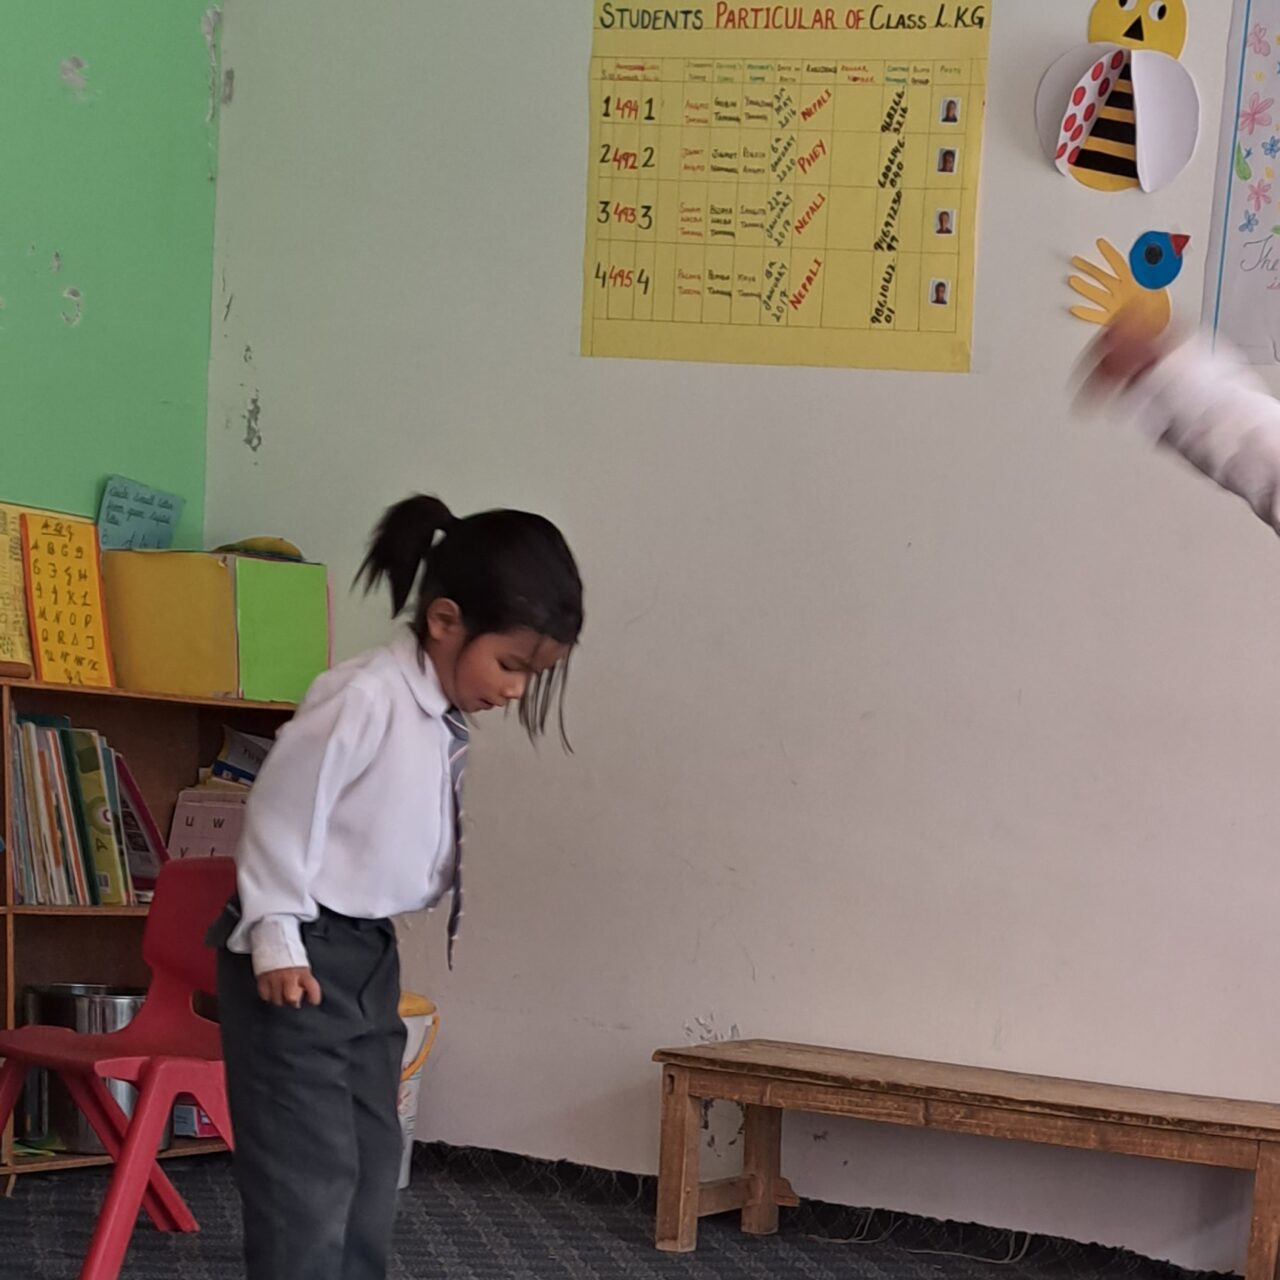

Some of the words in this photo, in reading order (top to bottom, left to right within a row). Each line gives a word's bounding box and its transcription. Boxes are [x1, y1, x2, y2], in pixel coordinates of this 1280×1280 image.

[600, 2, 703, 30] STUDENTS
[716, 1, 838, 30] PARTICULAR
[846, 9, 866, 30] OF
[870, 4, 927, 30] CLASS
[602, 95, 611, 117] 1
[643, 97, 656, 120] 1
[801, 88, 833, 122] NEPALI
[600, 144, 611, 163] 2
[612, 148, 639, 171] 492
[642, 147, 656, 168] 2
[597, 201, 611, 224] 3
[637, 205, 653, 230] 3
[794, 191, 826, 235] NEPALI
[1240, 234, 1280, 272] The
[594, 262, 607, 289] 4
[608, 265, 634, 289] 495
[637, 268, 650, 295] 4
[789, 256, 822, 311] NEPALI
